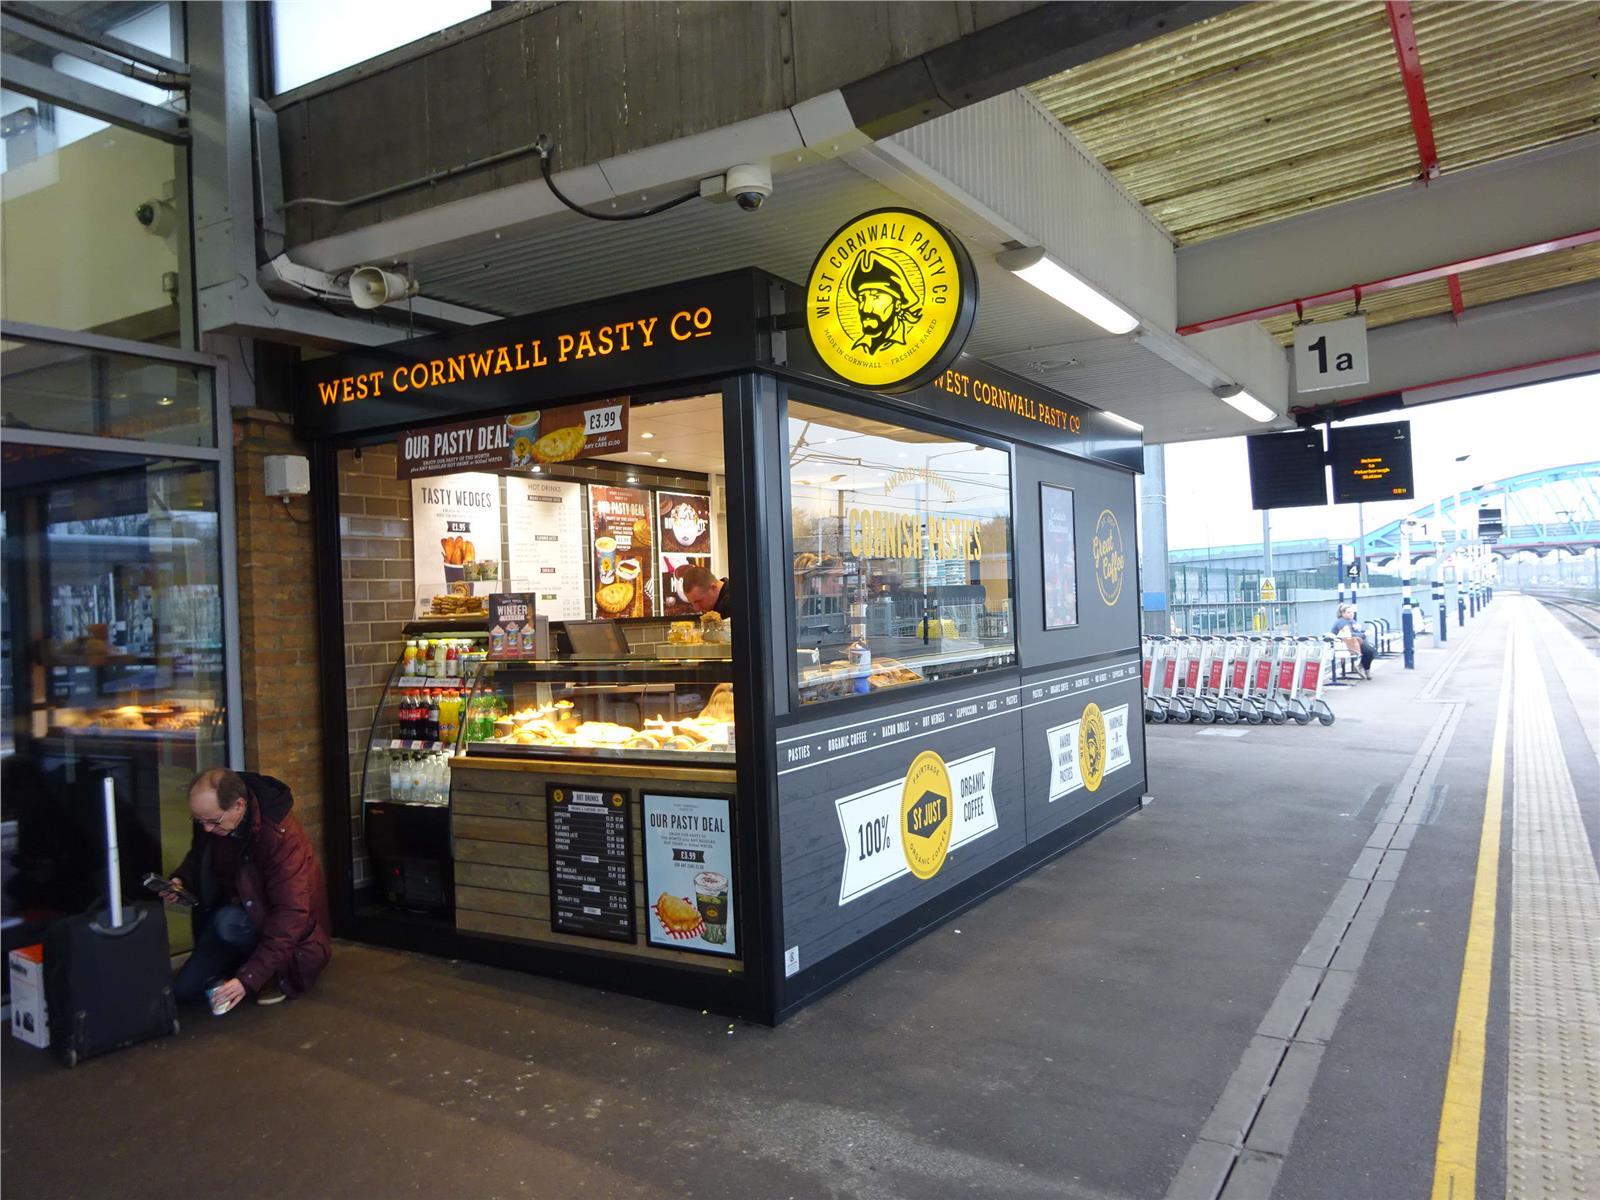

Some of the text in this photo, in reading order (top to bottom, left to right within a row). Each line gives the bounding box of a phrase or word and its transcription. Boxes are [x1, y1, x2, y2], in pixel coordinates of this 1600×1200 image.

[816, 272, 835, 319] WEST
[829, 223, 906, 269] CORNWALL
[910, 231, 946, 277] PASTY
[844, 354, 882, 369] CORNWALL
[891, 345, 920, 365] FRESHLY
[920, 318, 938, 343] BAKED
[318, 371, 385, 406] WEST
[392, 340, 548, 393] CORNWALL
[558, 316, 659, 363] PASTY
[973, 379, 1037, 420] CORNWALL
[1038, 403, 1067, 428] PASTY
[590, 411, 616, 430] £3.99
[404, 423, 510, 460] OUR PASTY DEAL
[421, 487, 492, 508] TASTY WEDGES
[850, 508, 982, 561] CORNISH PASTIES
[1421, 524, 1428, 535] 1
[1103, 551, 1124, 584] Coffee
[1349, 566, 1359, 577] 4
[497, 605, 528, 616] WINTER
[788, 745, 811, 762] PASTIES
[828, 735, 849, 751] ORGANIC
[850, 731, 867, 746] COFFEE
[912, 764, 940, 784] FAIRTRADE
[960, 771, 986, 798] ORGANIC
[650, 813, 725, 832] OUR PASTY DEAL
[923, 799, 942, 827] JUST
[963, 795, 984, 823] COFFEE
[858, 814, 890, 861] 100%
[909, 829, 947, 865] ORGANIC COFFEE
[680, 851, 696, 860] £3.99
